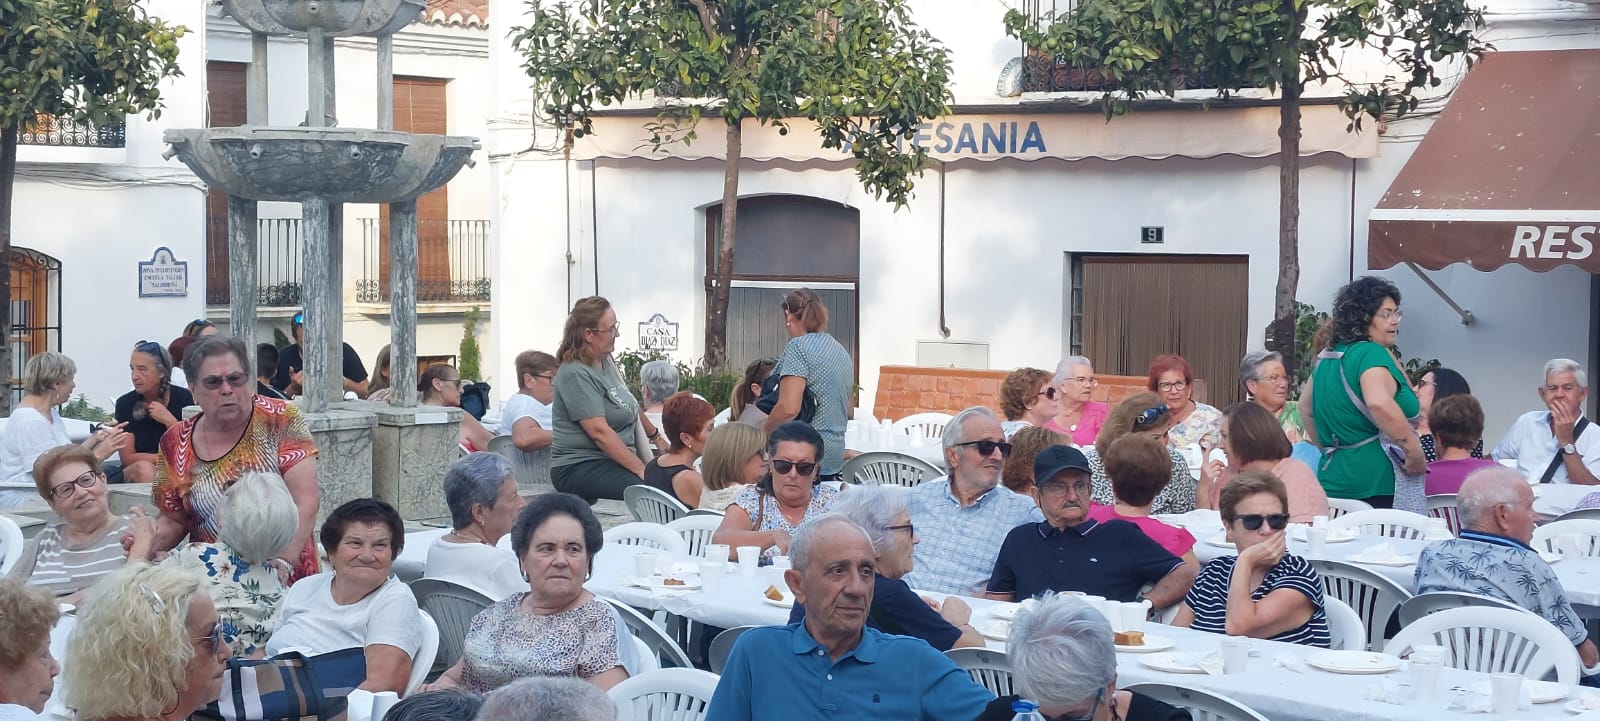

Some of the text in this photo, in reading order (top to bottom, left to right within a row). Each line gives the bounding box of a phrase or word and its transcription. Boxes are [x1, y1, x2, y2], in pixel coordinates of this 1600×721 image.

[842, 121, 1047, 154] TESANIA
[1148, 228, 1157, 241] 9
[1509, 225, 1600, 260] RES
[647, 327, 671, 336] CASA
